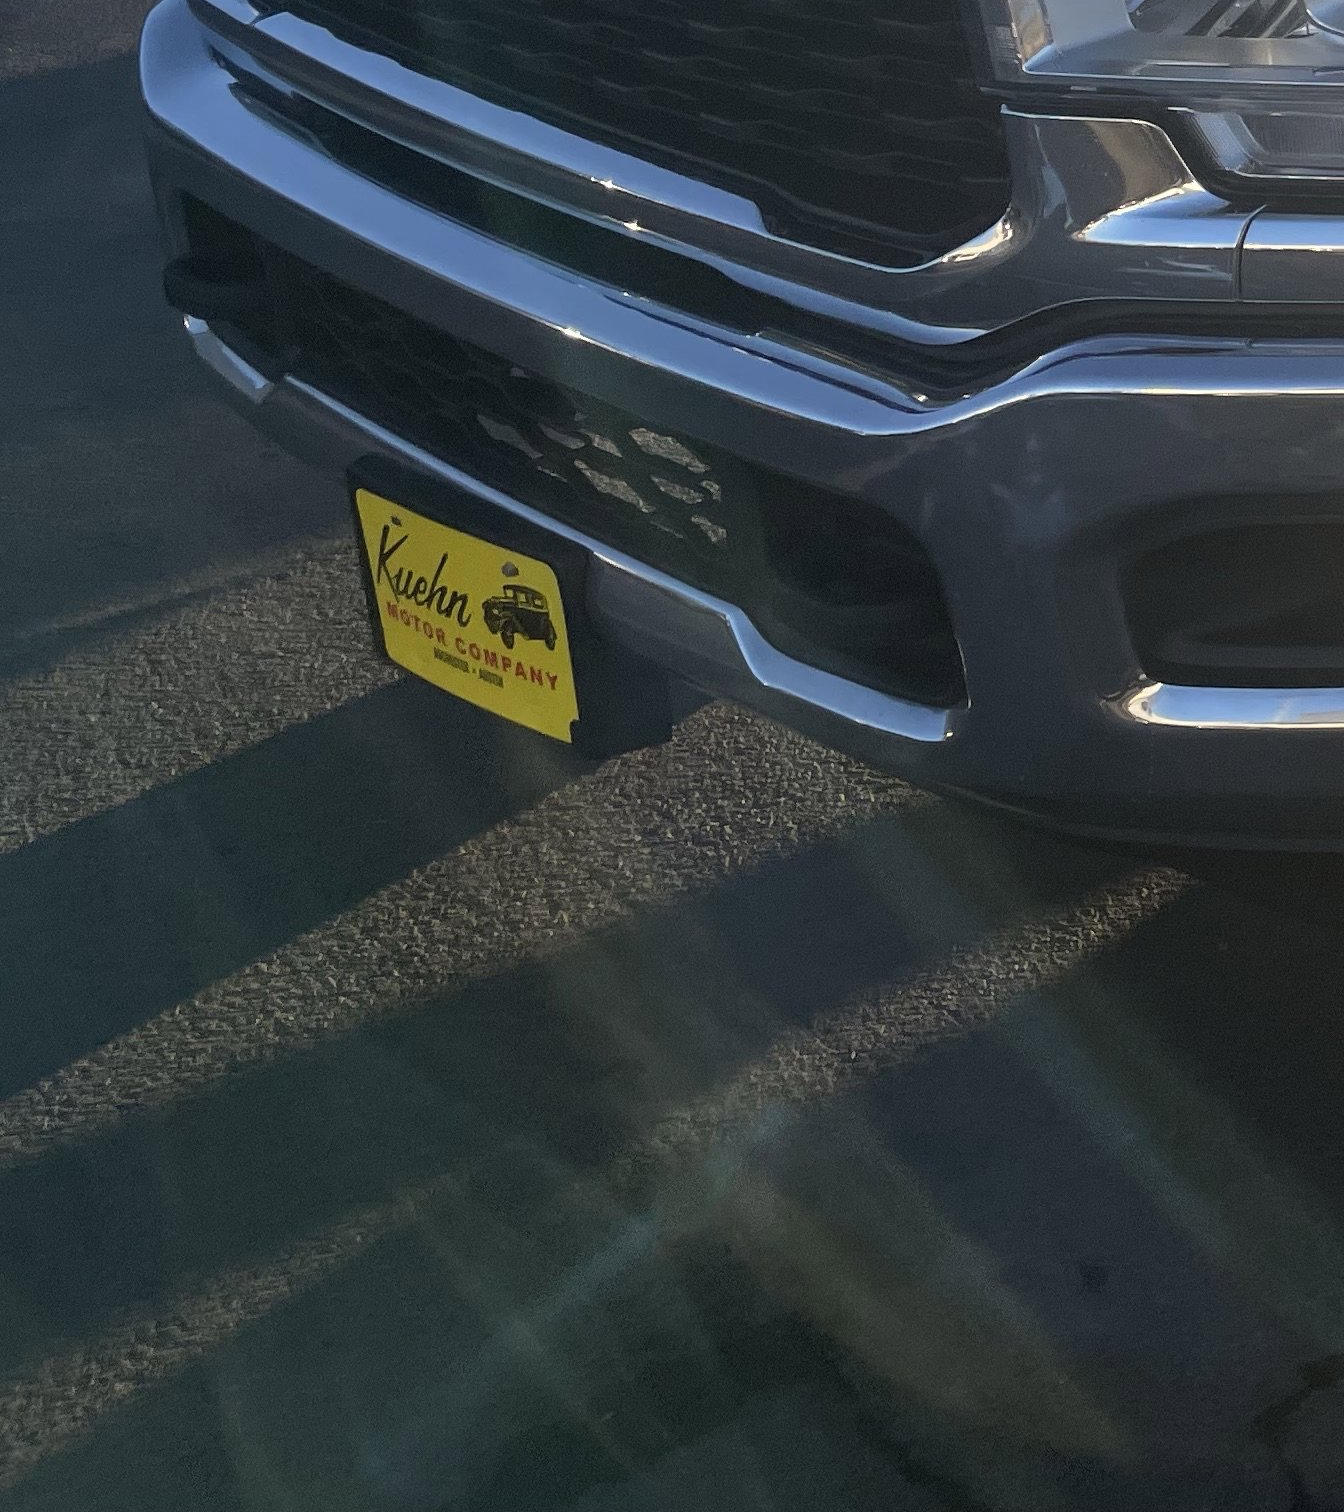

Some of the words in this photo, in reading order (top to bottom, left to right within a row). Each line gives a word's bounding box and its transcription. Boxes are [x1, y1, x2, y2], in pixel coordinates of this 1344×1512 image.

[377, 525, 472, 628] Kuehn
[386, 600, 448, 651] MOTOR
[454, 637, 559, 691] COMPANY
